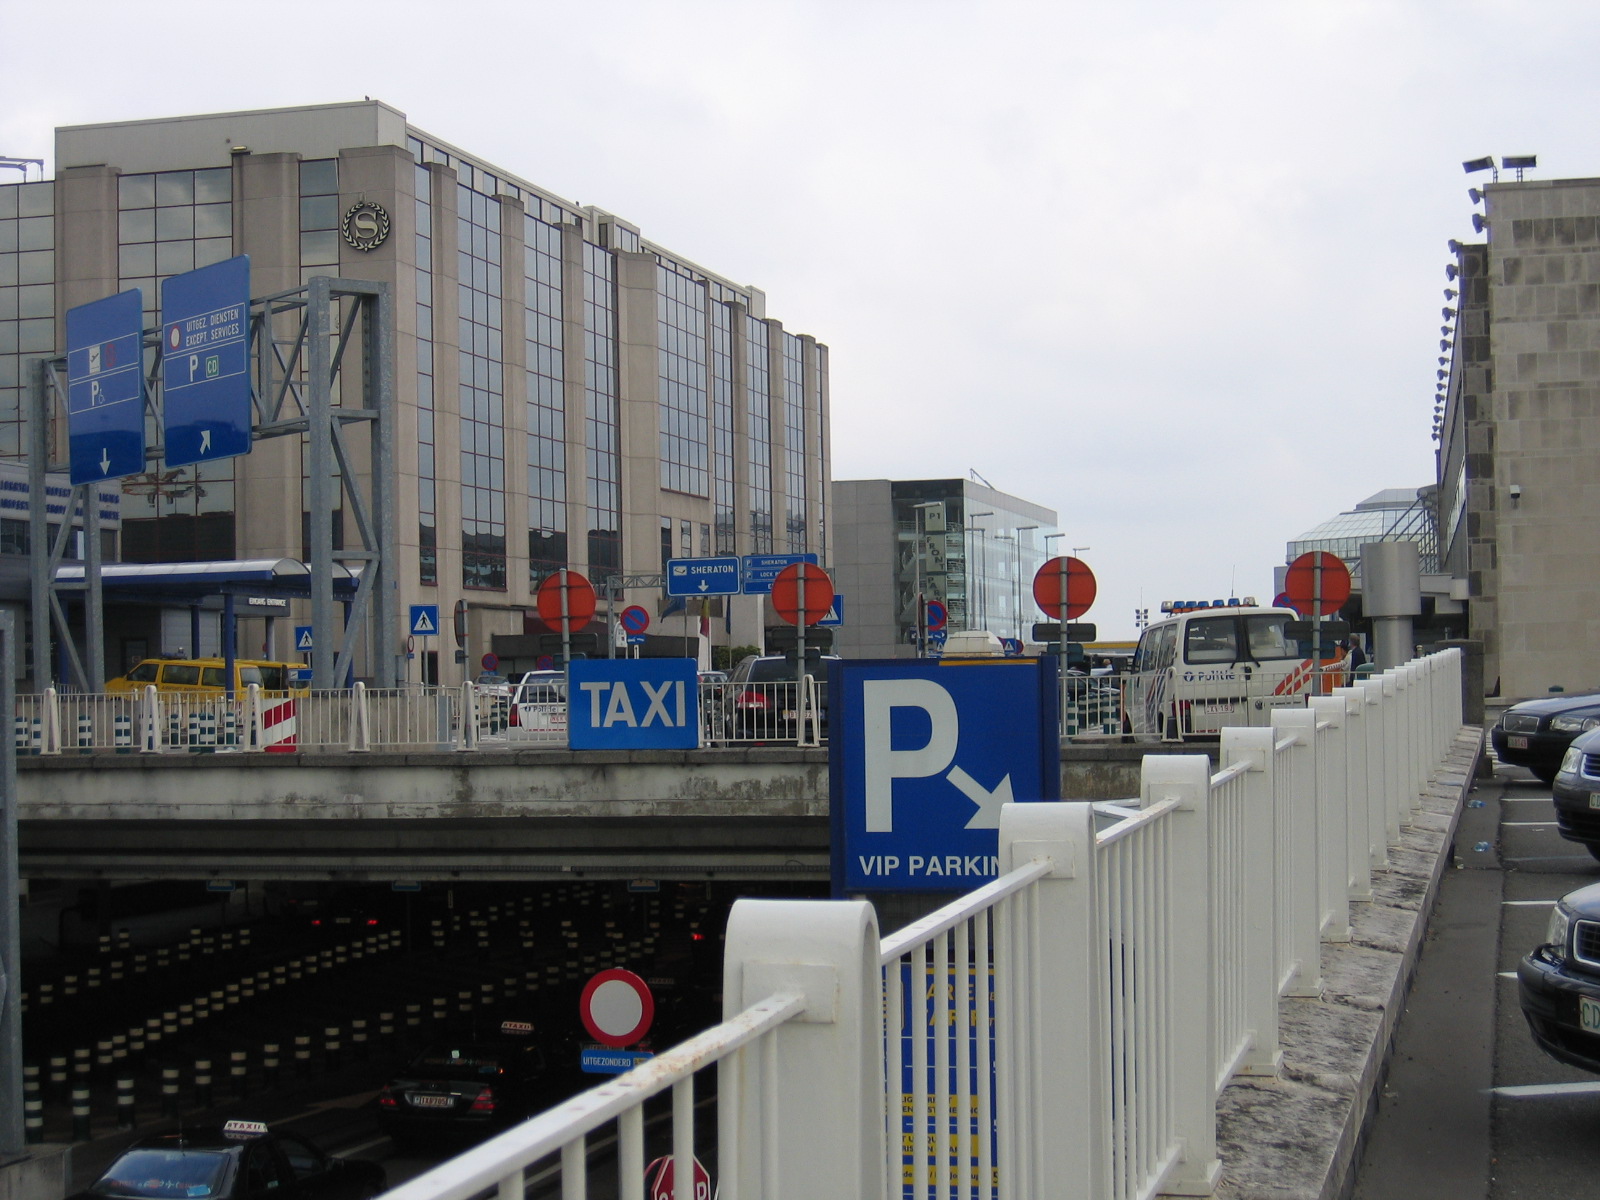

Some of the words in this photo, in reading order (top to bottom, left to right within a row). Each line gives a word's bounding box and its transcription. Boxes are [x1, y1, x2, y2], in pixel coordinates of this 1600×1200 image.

[210, 308, 239, 326] DIENSTEN
[211, 323, 240, 340] SERVICES
[190, 354, 199, 382] P
[207, 360, 217, 374] CD
[91, 380, 99, 406] P
[929, 512, 941, 520] P1
[926, 536, 945, 570] FRONT
[690, 565, 734, 575] SHERATON
[1198, 670, 1235, 681] Politie
[580, 680, 686, 728] TAXI
[863, 678, 959, 833] P
[859, 855, 900, 876] VIP
[583, 1056, 631, 1067] UITGEZONDERD
